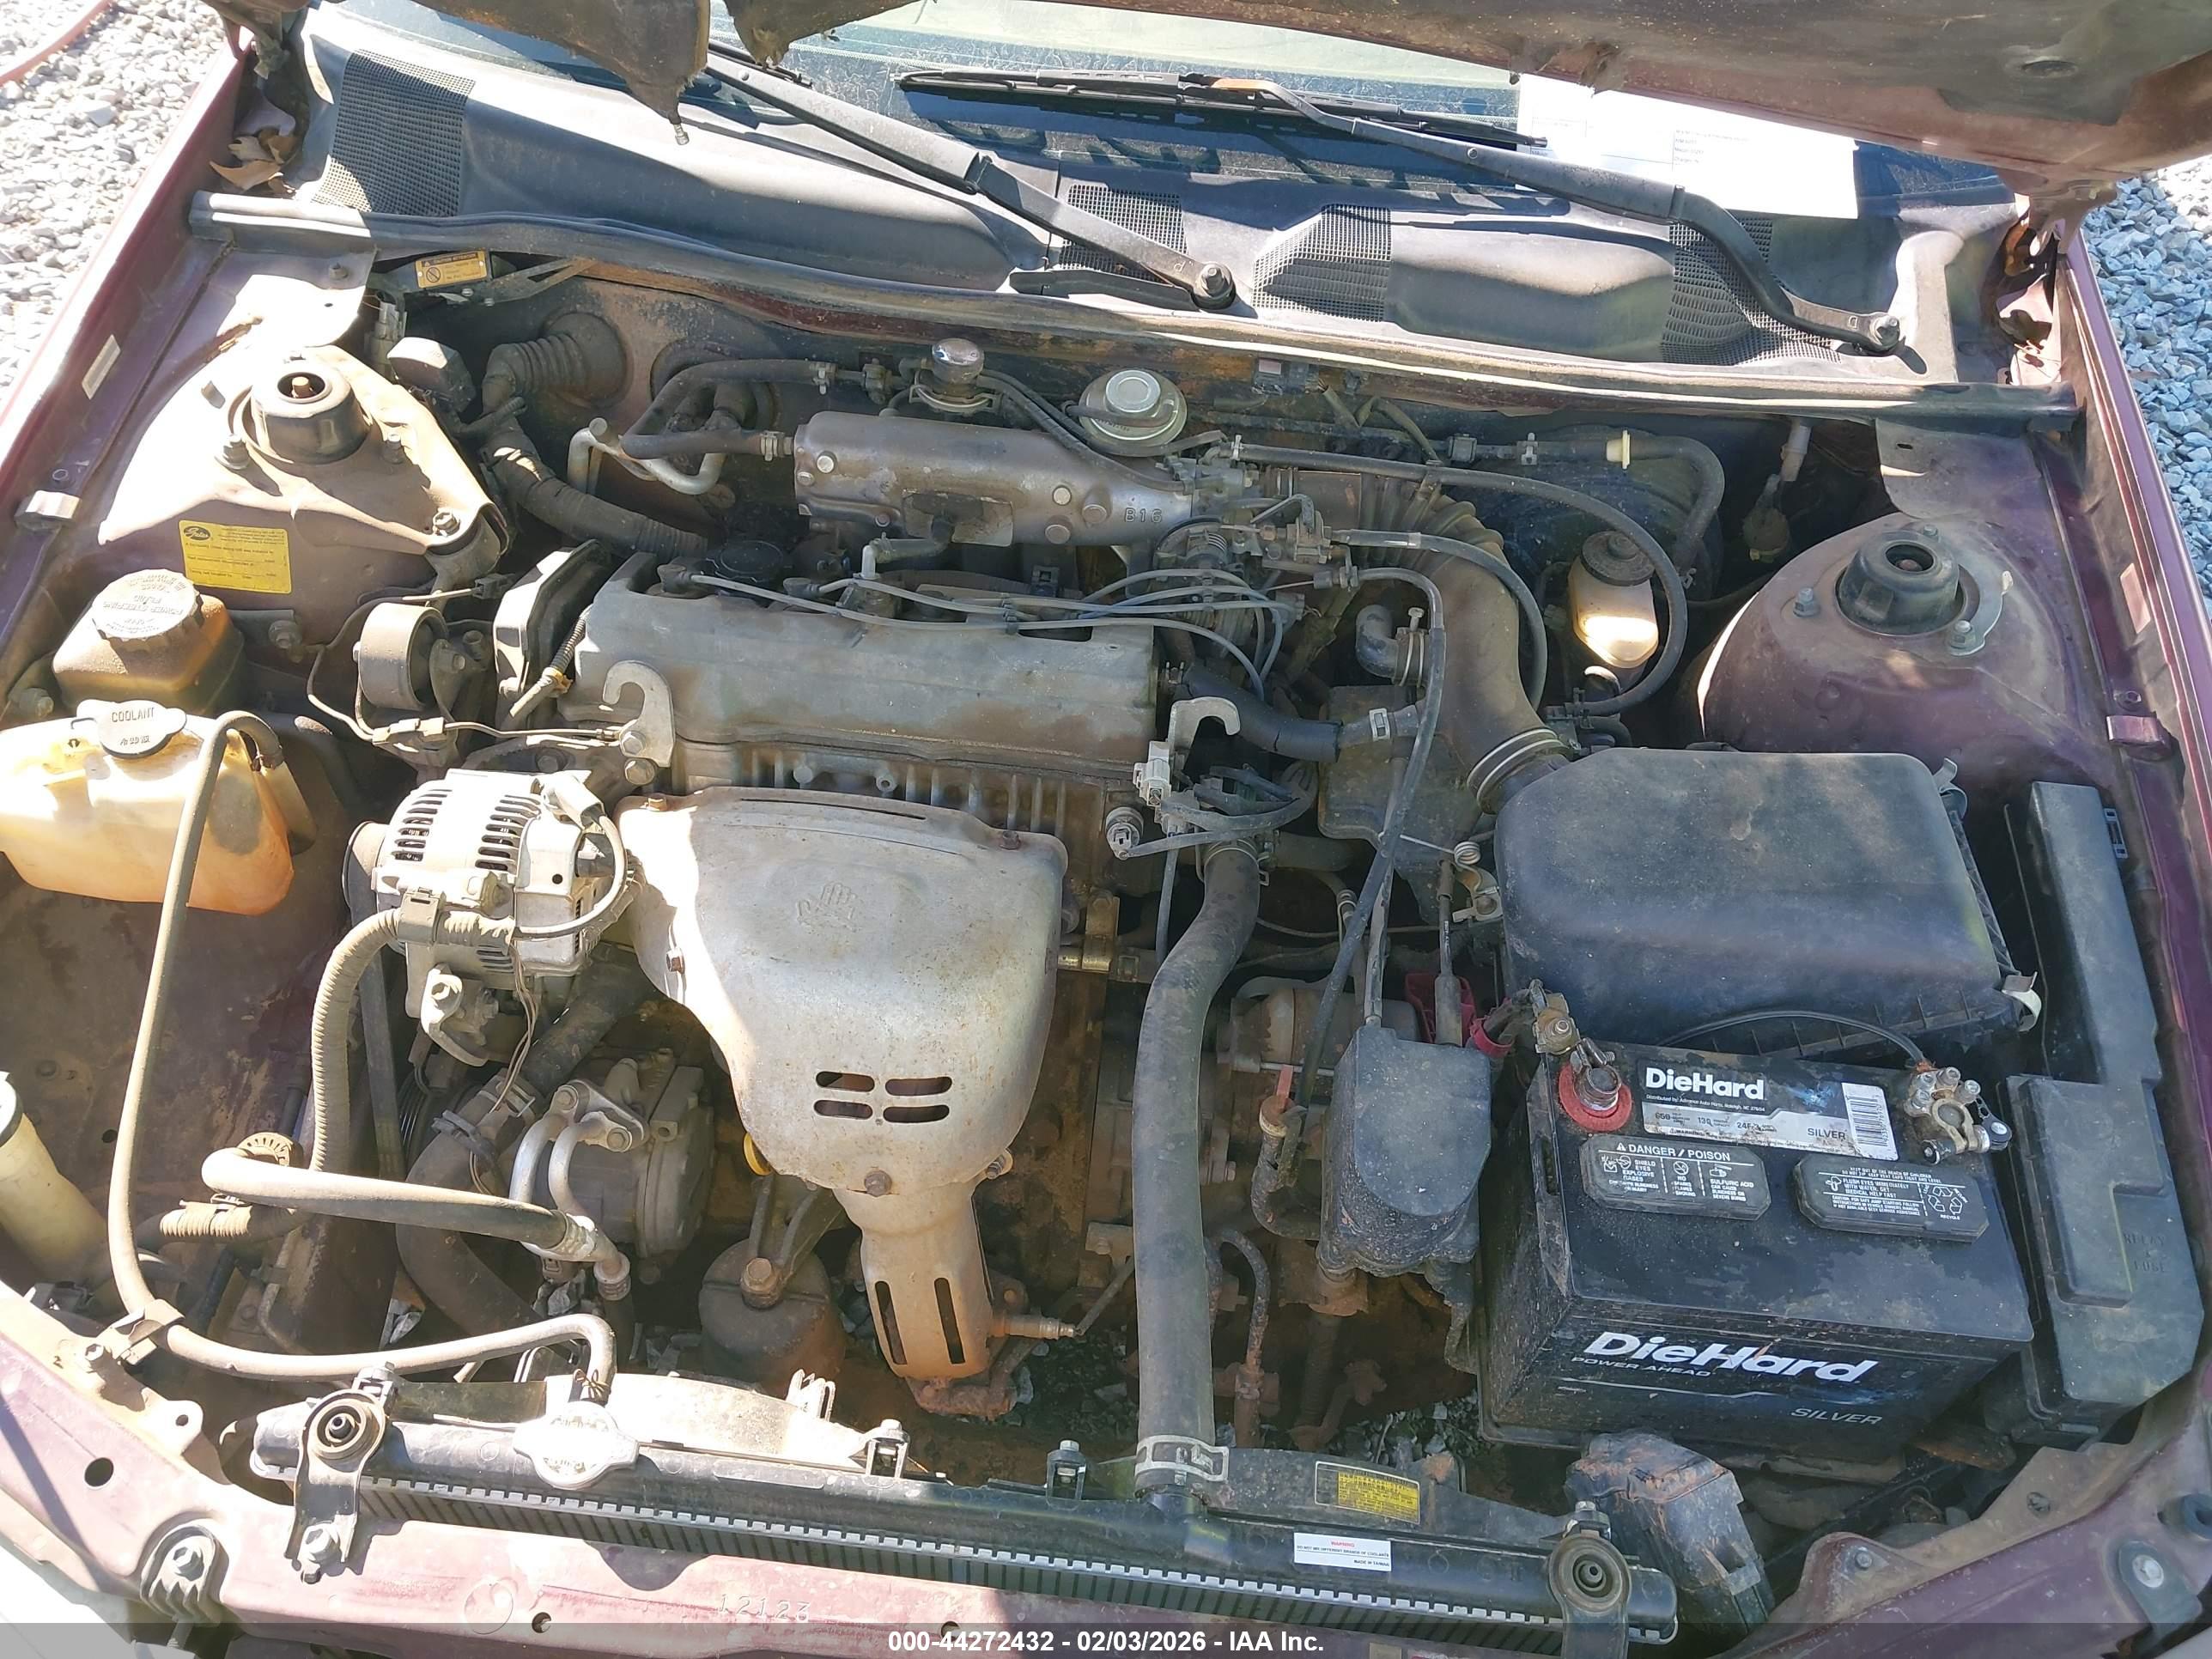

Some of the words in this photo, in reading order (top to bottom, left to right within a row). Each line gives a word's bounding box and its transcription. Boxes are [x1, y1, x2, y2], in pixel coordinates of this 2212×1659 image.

[1125, 507, 1162, 523] B16
[112, 707, 155, 723] COOLANT
[1646, 1067, 1764, 1100] DieHard
[1808, 1127, 1846, 1139] SILVER
[1628, 1144, 1676, 1157] DANGER
[1687, 1150, 1730, 1161] POISON
[1583, 1331, 1879, 1382] DieHard
[1571, 1356, 1639, 1369] POWER
[1645, 1364, 1711, 1377] AHEAD
[1791, 1407, 1882, 1425] SILVER
